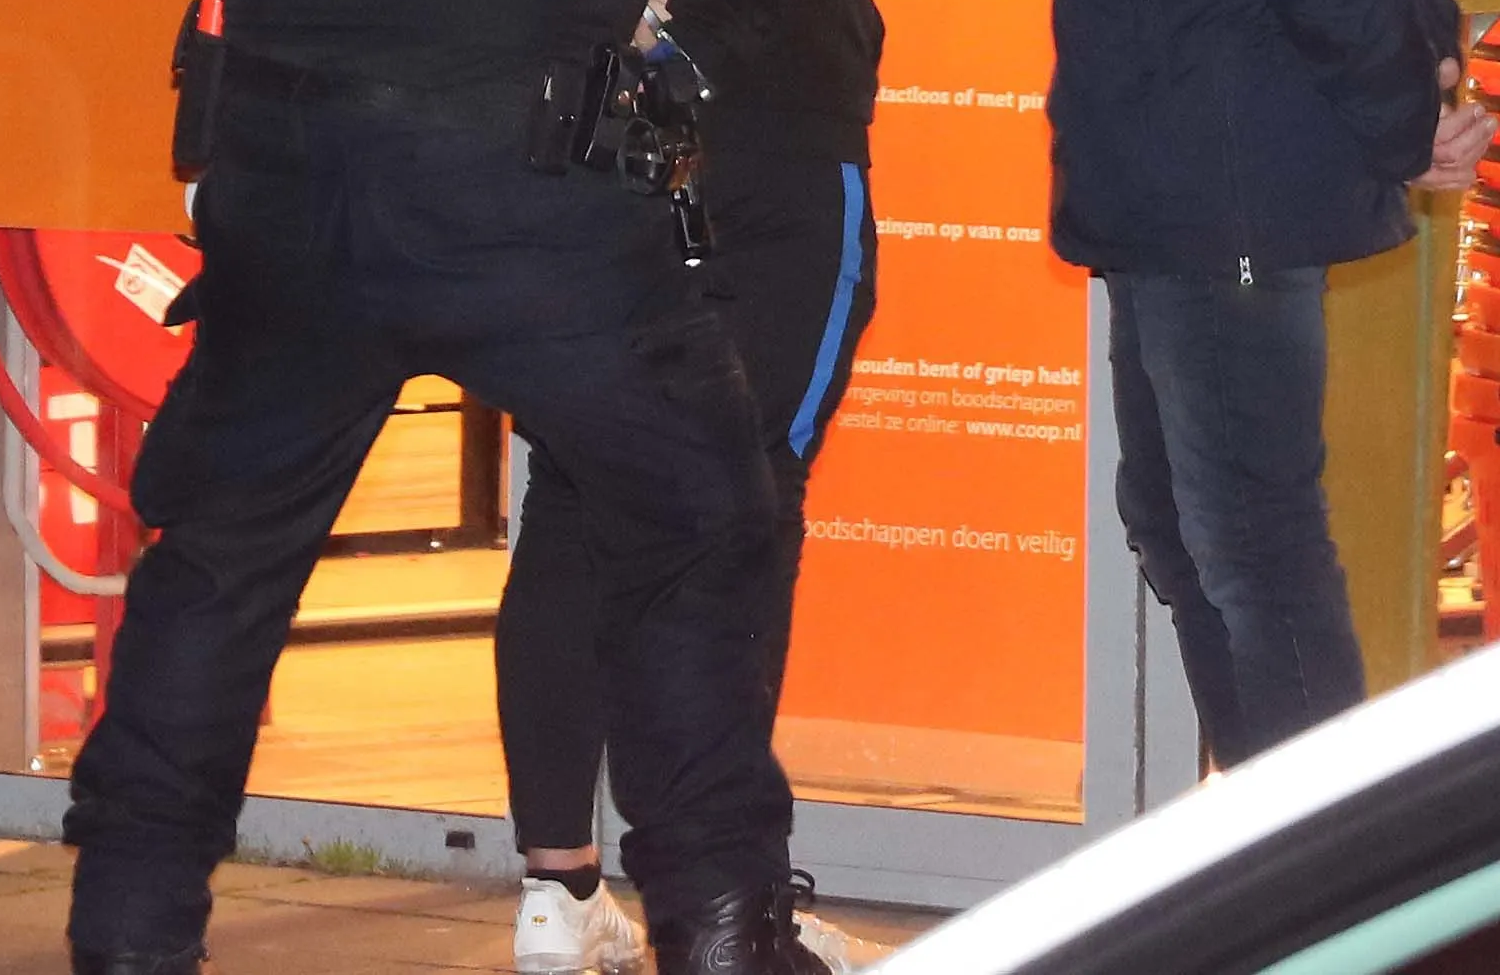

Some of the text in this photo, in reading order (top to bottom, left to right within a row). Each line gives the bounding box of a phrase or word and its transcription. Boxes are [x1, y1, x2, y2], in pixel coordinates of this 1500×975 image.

[875, 86, 950, 106] tactloos
[953, 88, 975, 106] of
[977, 90, 1015, 110] met
[939, 223, 964, 242] op
[968, 224, 1003, 240] van
[1006, 225, 1043, 243] ons
[917, 359, 961, 378] bent
[963, 361, 984, 379] of
[984, 364, 1034, 387] griep
[1038, 365, 1081, 386] hebt
[847, 384, 1077, 415] mgeving om boodschappen
[884, 413, 904, 429] ze
[965, 419, 1082, 442] www.coop.nl
[951, 524, 1011, 553] doen
[1016, 529, 1077, 562] veilig
